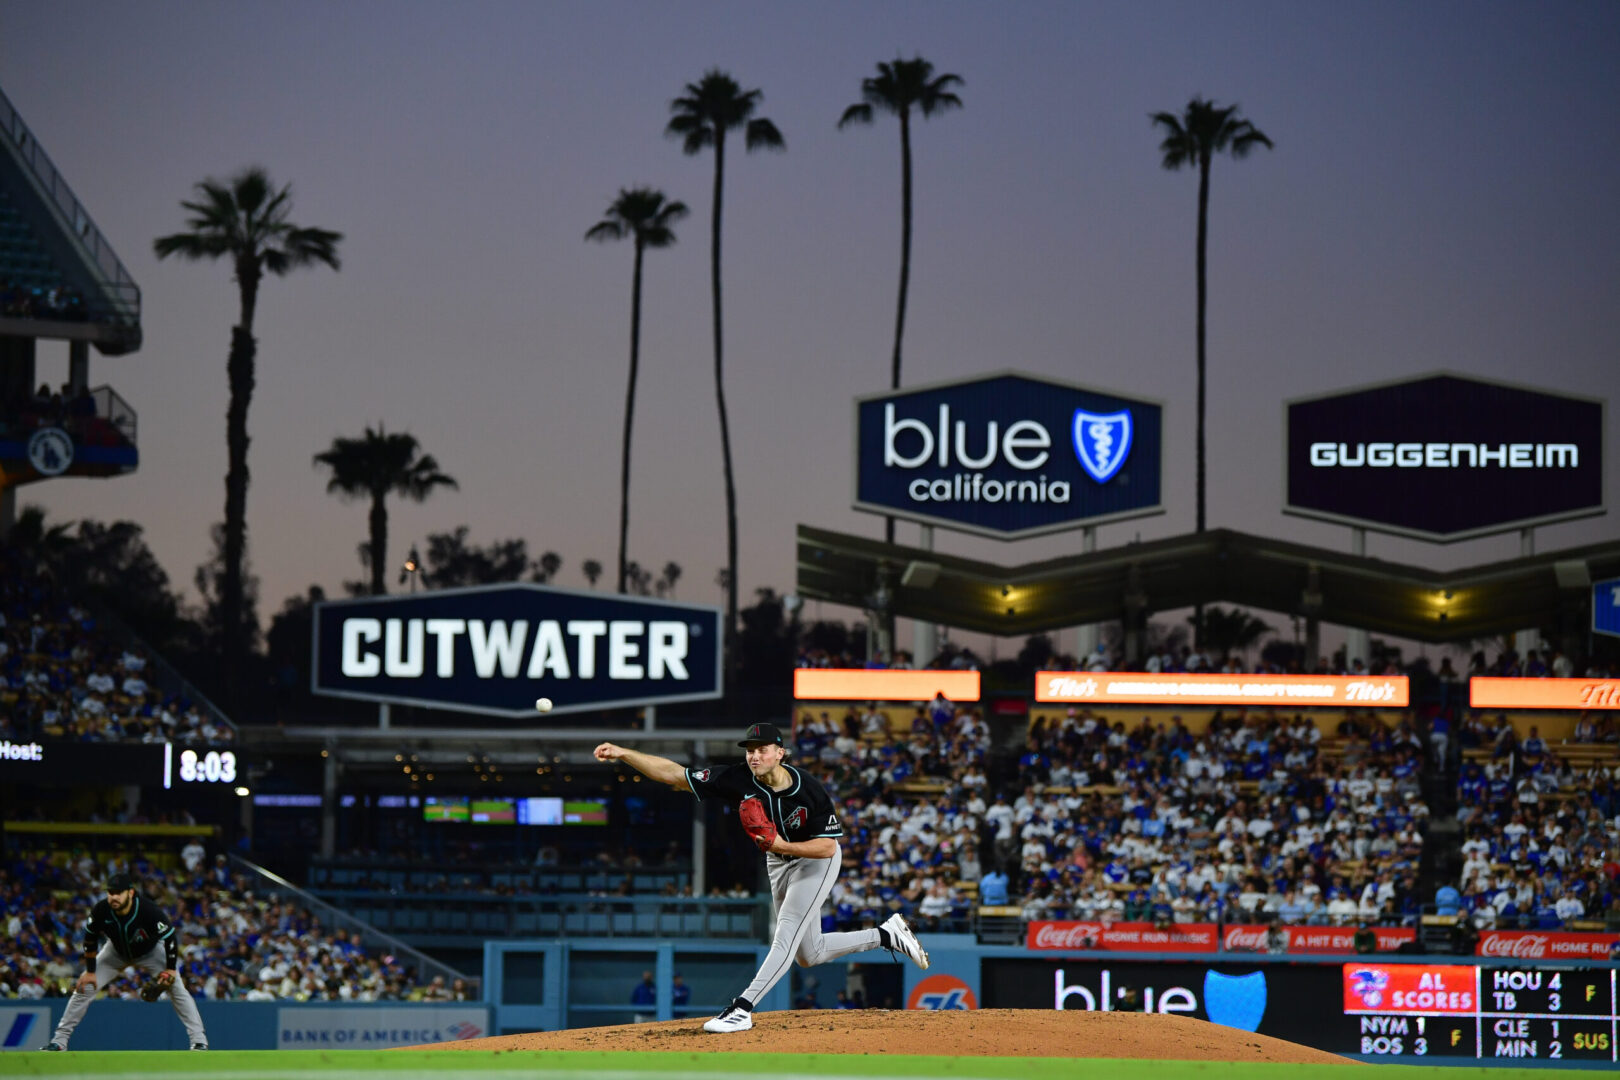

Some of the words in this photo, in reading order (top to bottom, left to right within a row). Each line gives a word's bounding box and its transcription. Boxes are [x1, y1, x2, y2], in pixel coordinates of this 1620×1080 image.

[884, 403, 1051, 470] blue
[1309, 442, 1579, 468] GUGGENHEIM
[909, 473, 1070, 503] california
[342, 618, 690, 680] CUTWATER
[1345, 680, 1396, 701] Tito's
[1580, 682, 1620, 707] Tit
[180, 750, 237, 783] 8:03
[1103, 931, 1139, 943] HOME
[1141, 932, 1168, 943] RUN
[1294, 935, 1306, 947] A
[1307, 935, 1330, 948] HIT
[1551, 942, 1589, 953] HOME
[1418, 972, 1446, 991] AL
[1493, 970, 1542, 991] HOU
[1548, 972, 1562, 991] 4
[1391, 990, 1472, 1009] SCORES
[1492, 991, 1517, 1010] TB
[1548, 993, 1561, 1012] 3
[1585, 984, 1596, 1002] F
[281, 1029, 329, 1043] BANK
[334, 1029, 357, 1043] OF
[361, 1029, 442, 1043] AMERICA
[1360, 1016, 1409, 1035] NYM
[1416, 1017, 1426, 1036] 1
[1493, 1019, 1530, 1038] CLE
[1551, 1020, 1560, 1039] 1
[1360, 1036, 1404, 1055] BOS
[1414, 1037, 1428, 1056] 3
[1451, 1029, 1462, 1047] F
[1573, 1032, 1609, 1050] SUS
[1495, 1039, 1538, 1058] MIN
[1549, 1041, 1562, 1058] 2
